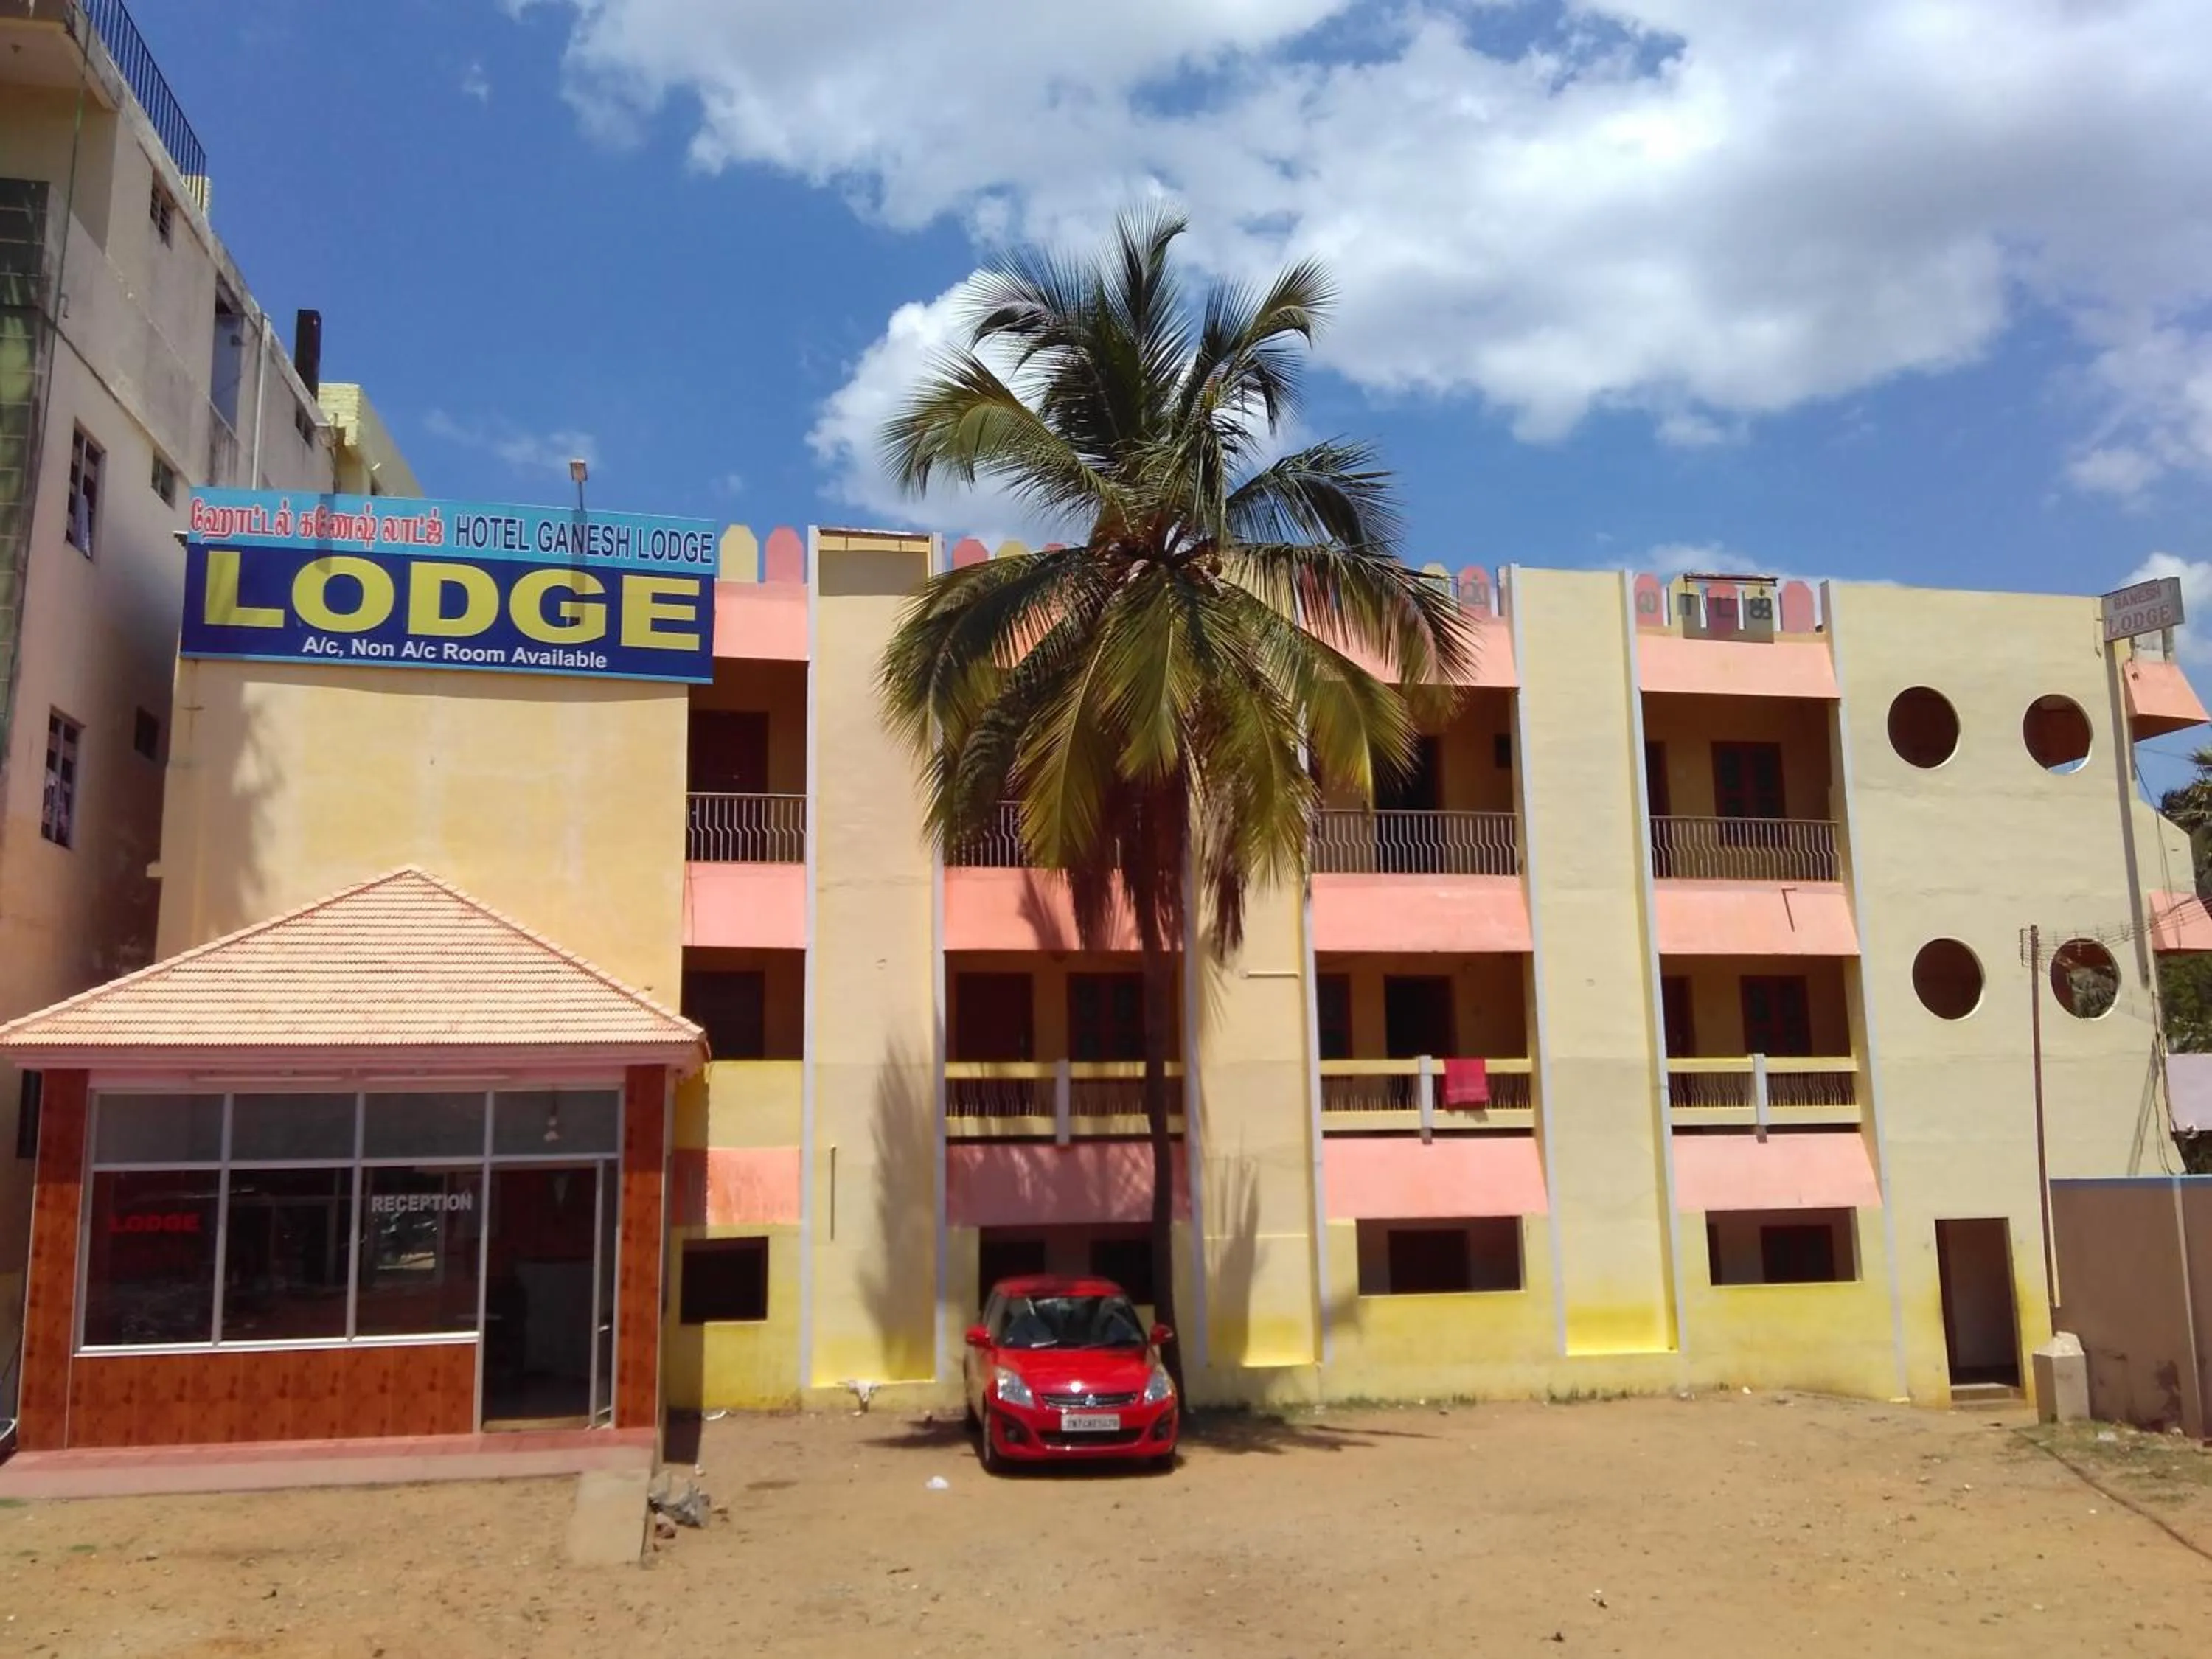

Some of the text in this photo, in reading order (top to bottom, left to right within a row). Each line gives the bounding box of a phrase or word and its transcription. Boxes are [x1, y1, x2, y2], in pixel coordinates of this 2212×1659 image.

[456, 515, 713, 563] HOTEL GANESH LODGE
[204, 551, 700, 651] LODGE
[2108, 604, 2171, 637] LODGE
[302, 636, 607, 669] A/c, Non A/c Room Available
[371, 1192, 473, 1213] RECEPTION
[108, 1212, 200, 1233] LODGE
